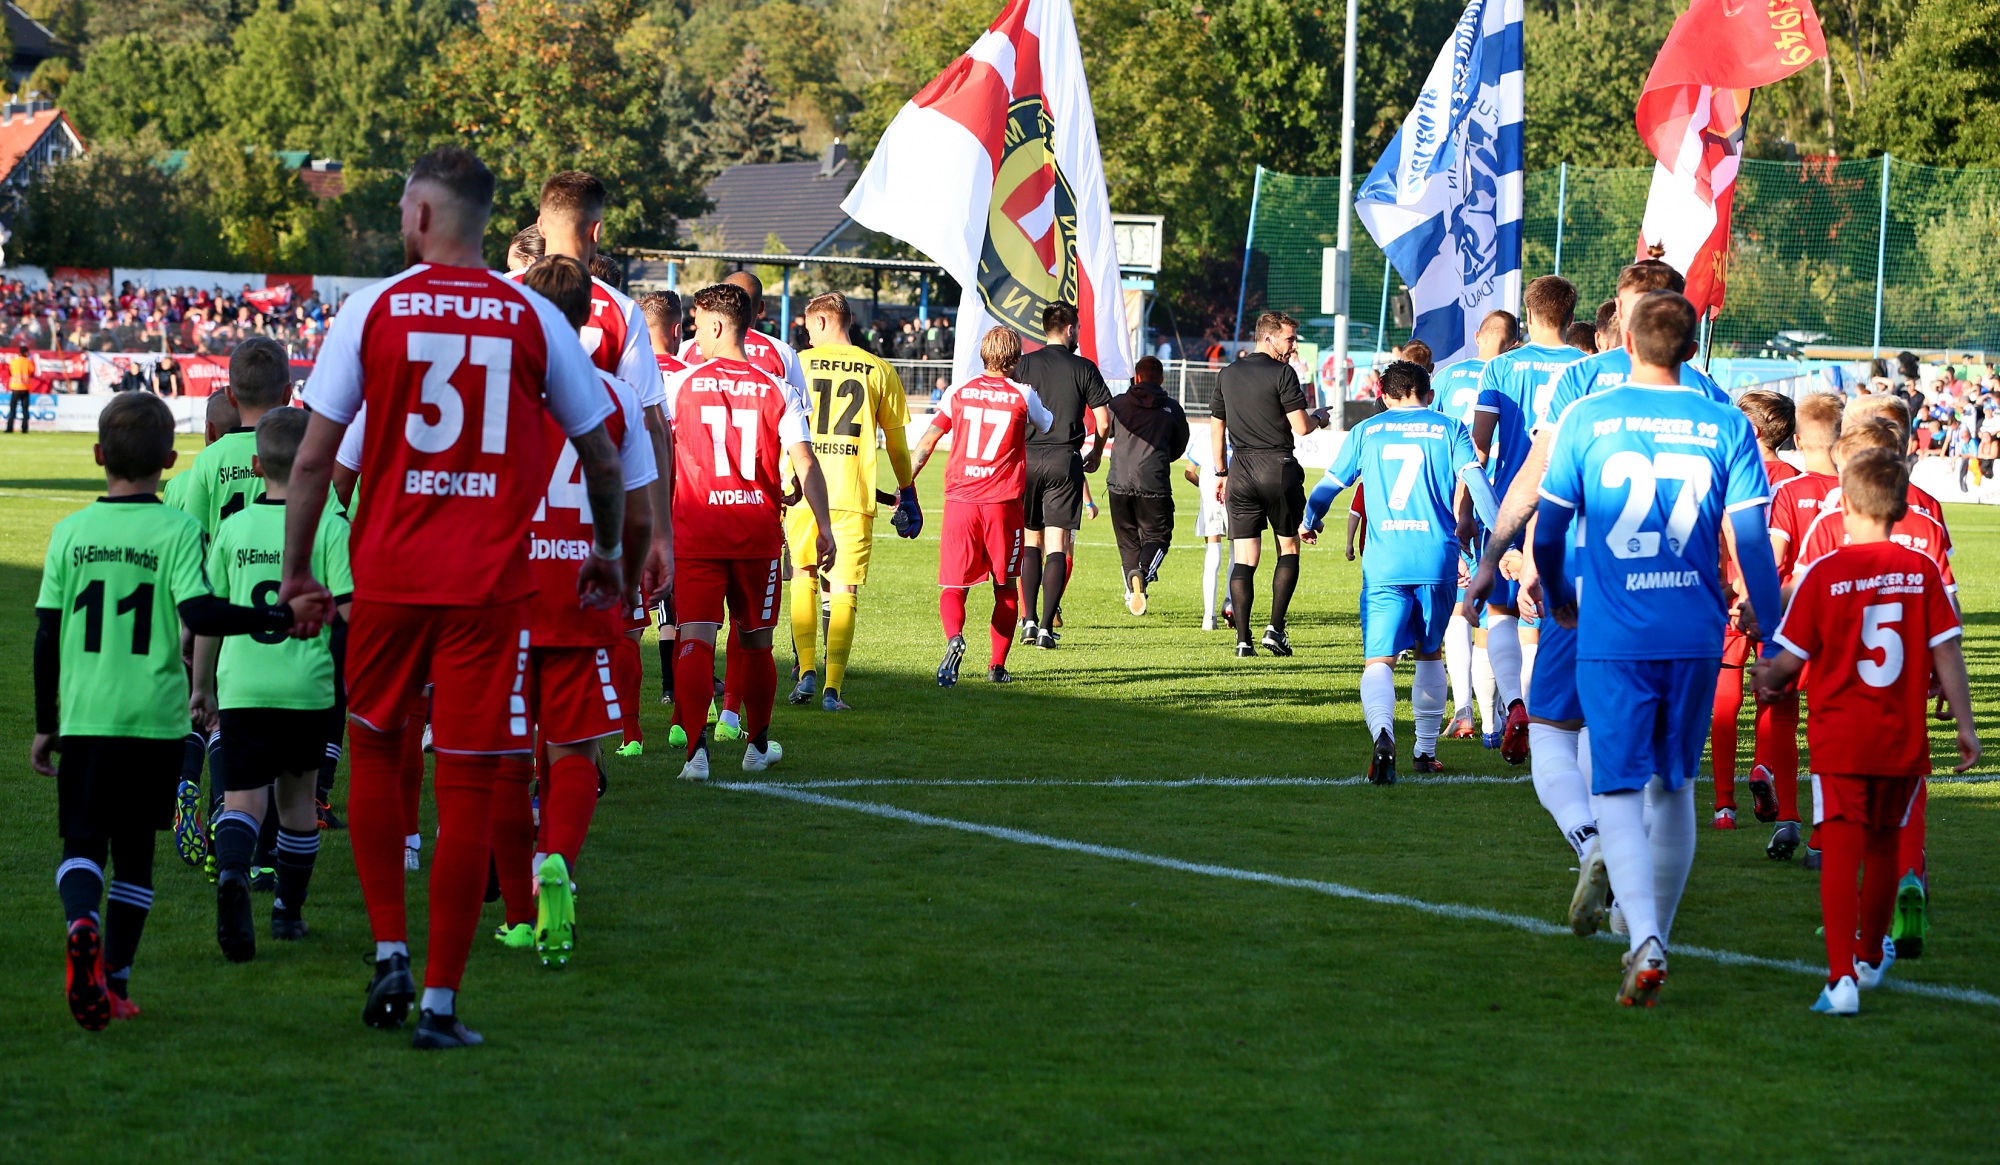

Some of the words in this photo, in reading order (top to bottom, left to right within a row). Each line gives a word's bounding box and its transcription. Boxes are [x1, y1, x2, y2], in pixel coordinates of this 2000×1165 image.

[390, 292, 525, 325] ERFURT
[810, 359, 875, 375] ERFURT
[1597, 372, 1624, 387] FSV
[405, 331, 513, 455] 31
[691, 377, 771, 398] ERFURT
[961, 387, 1020, 404] ERFURT
[813, 378, 865, 438] 12
[1451, 387, 1478, 426] 2
[963, 405, 1012, 461] 17
[1366, 424, 1384, 436] FSV
[1385, 422, 1429, 432] WACKER
[1430, 424, 1445, 433] 90
[1594, 417, 1623, 437] FSV
[1625, 416, 1694, 435] WACKER
[1697, 422, 1719, 438] 90
[701, 405, 758, 481] 11
[220, 466, 257, 485] SV-Einhe
[405, 469, 497, 497] BECKEN
[1382, 444, 1424, 511] 7
[1601, 450, 1713, 560] 27
[529, 532, 590, 560] ÜDIGER
[1913, 537, 1928, 549] 90
[74, 545, 122, 568] SV-Einheit
[125, 547, 158, 572] Worbis
[237, 549, 280, 568] SV-Einheit
[1831, 581, 1852, 596] FSV
[1855, 573, 1904, 591] WACKER
[1906, 573, 1924, 585] 90
[72, 580, 155, 655] 11
[1856, 602, 1904, 688] 5
